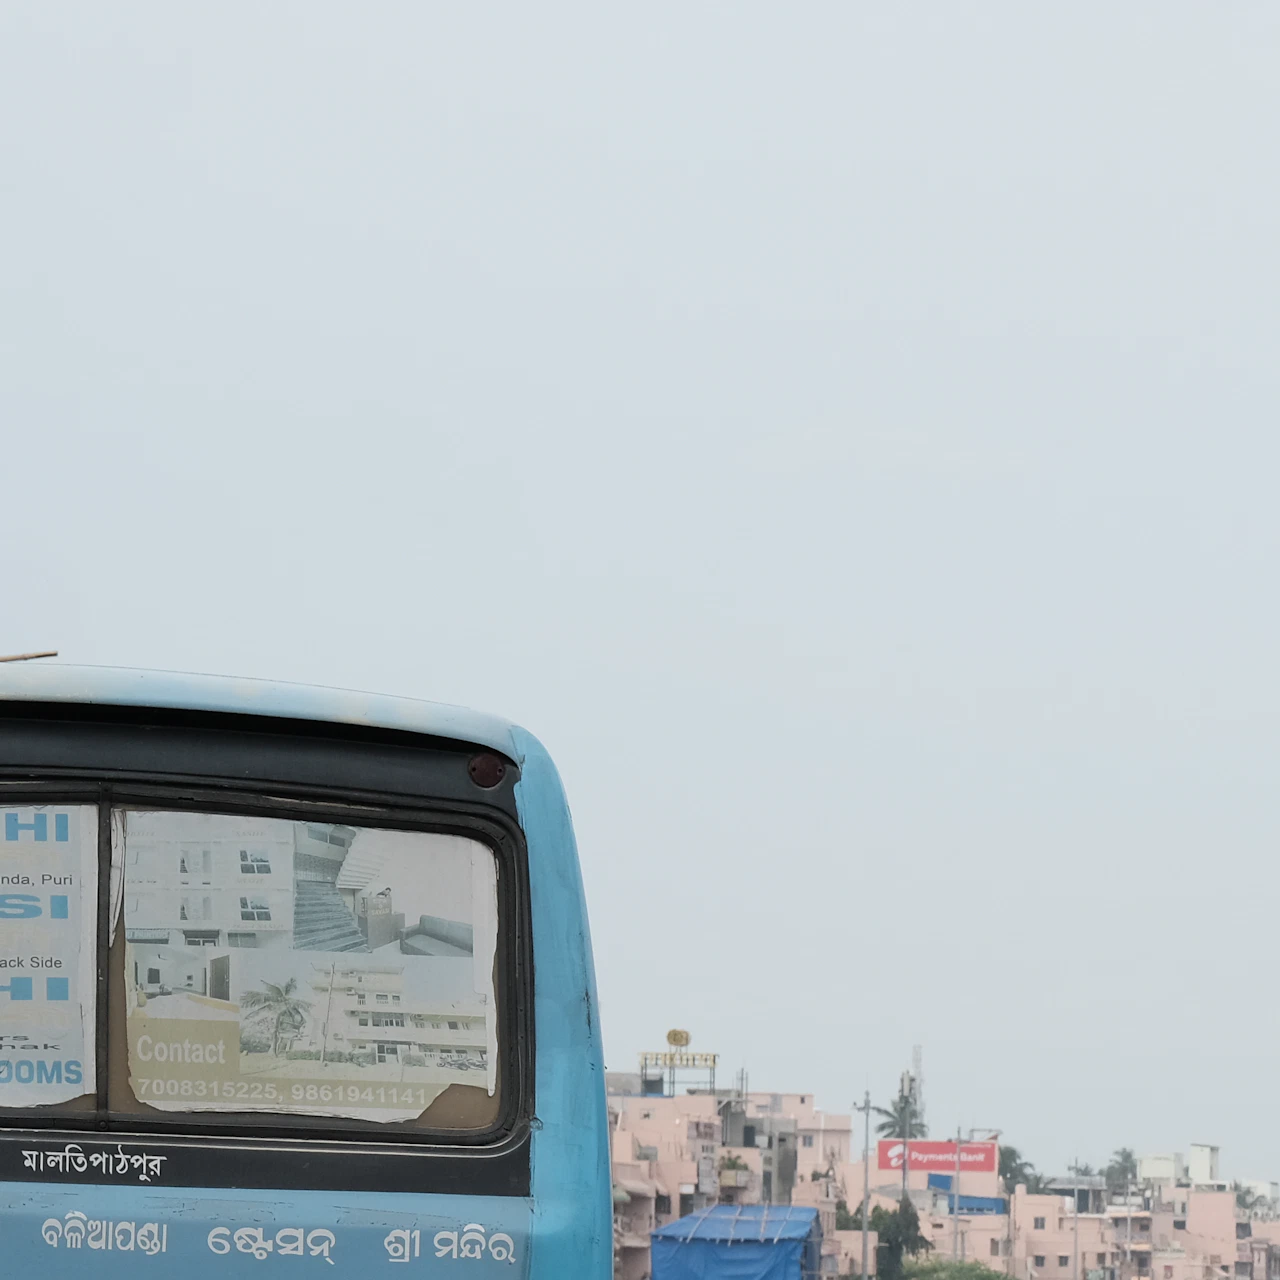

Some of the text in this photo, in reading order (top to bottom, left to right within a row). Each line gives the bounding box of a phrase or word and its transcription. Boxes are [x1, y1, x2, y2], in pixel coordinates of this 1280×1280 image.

[41, 874, 73, 886] Puri
[30, 956, 63, 968] Side
[136, 1034, 226, 1065] Contact
[138, 1079, 426, 1104] 7008315225, 9861941141
[911, 1150, 986, 1163] Payments Bank
